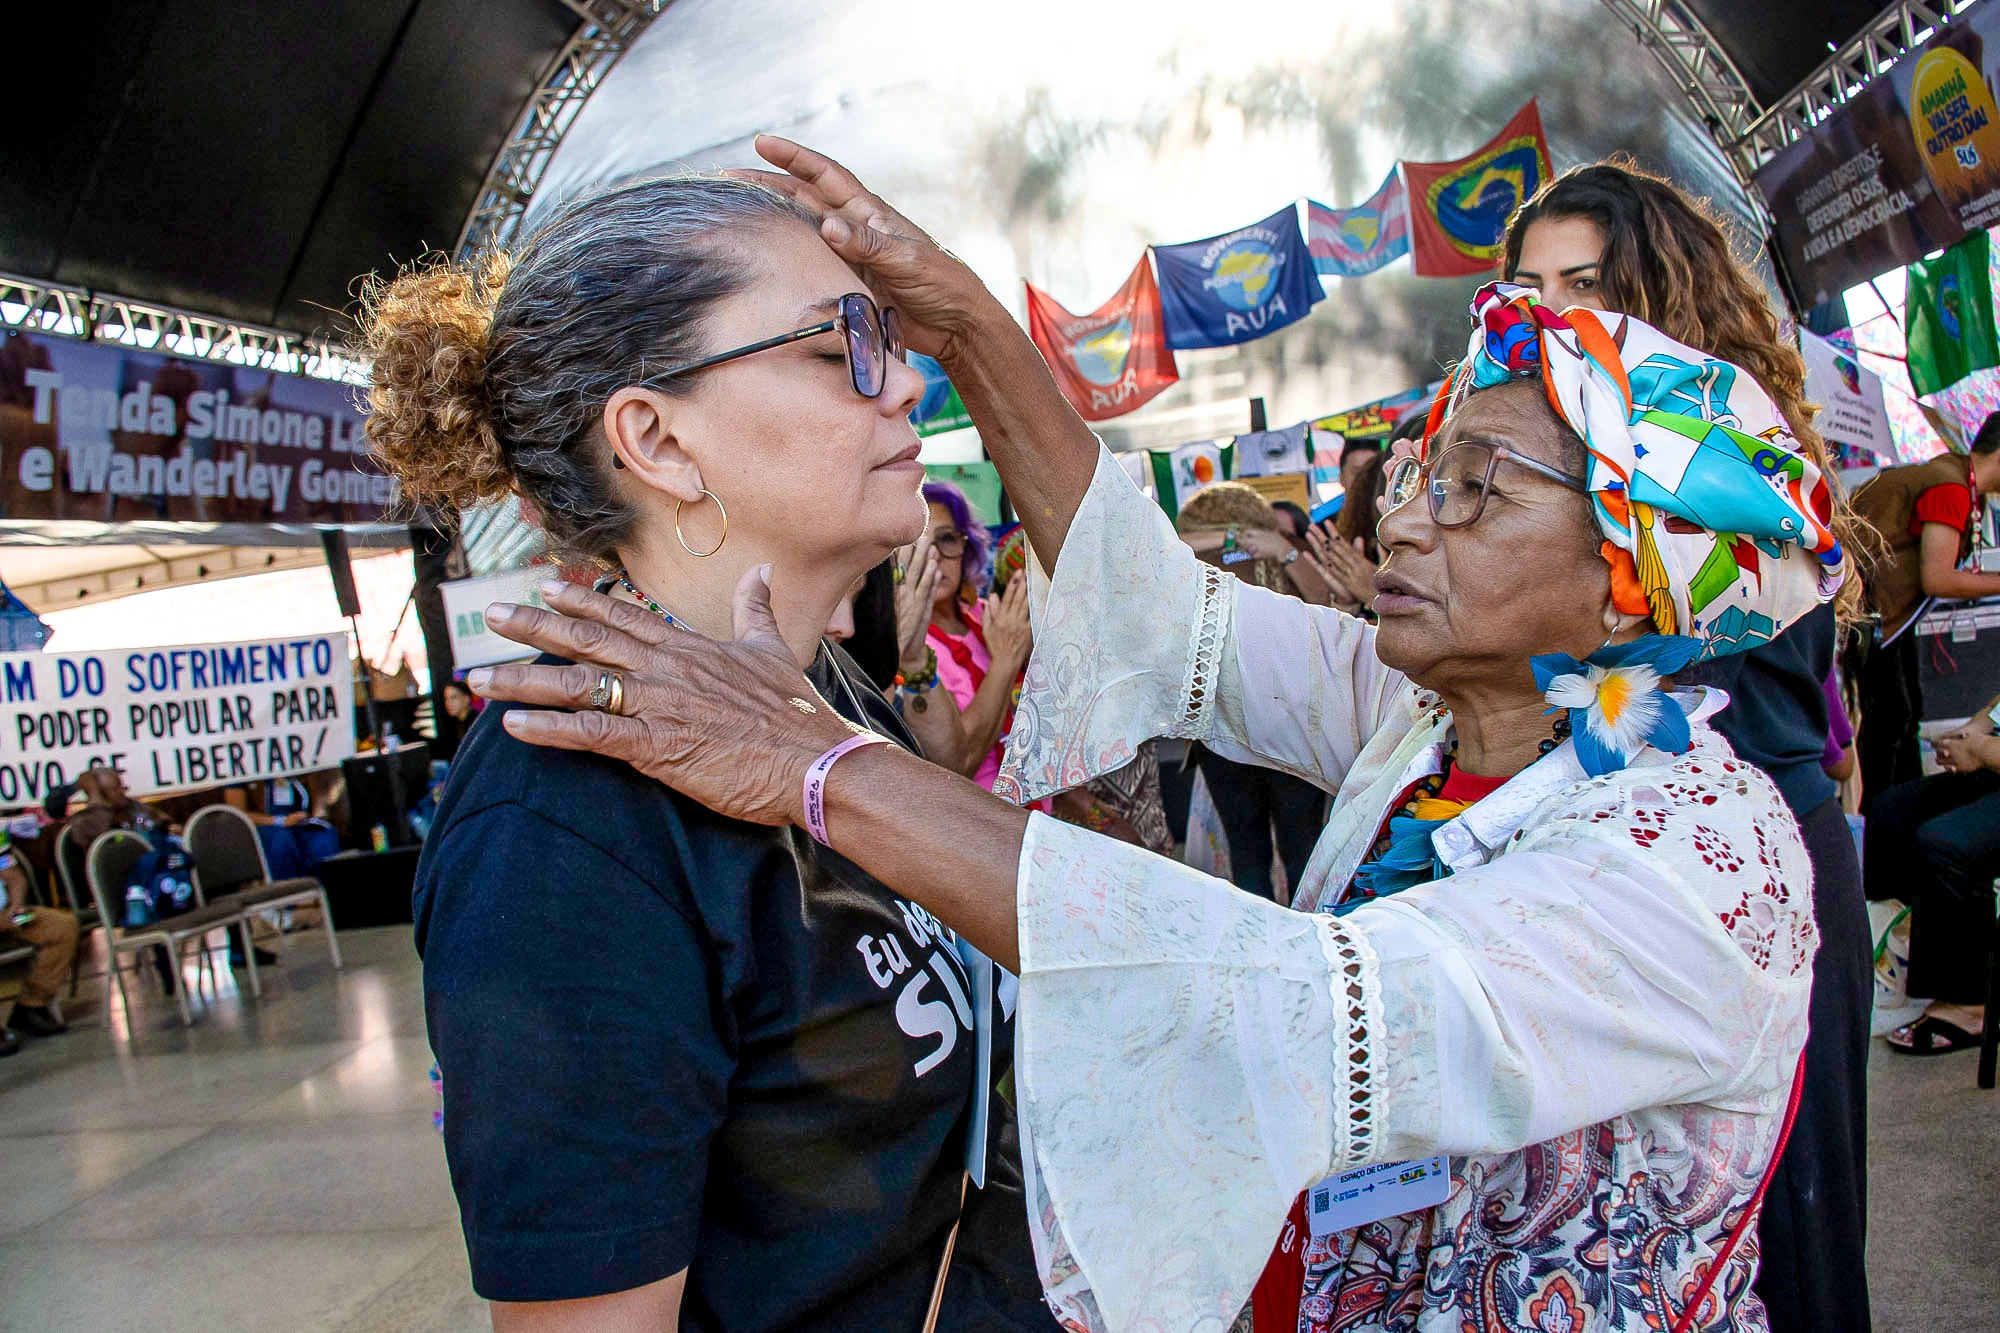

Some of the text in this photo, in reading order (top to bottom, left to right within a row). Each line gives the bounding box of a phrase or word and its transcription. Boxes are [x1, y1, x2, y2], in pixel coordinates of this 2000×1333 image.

[1948, 95, 1971, 118] SER
[1927, 120, 1965, 157] OUTRO
[1956, 144, 1978, 165] SUS
[24, 367, 177, 436] Tenda
[186, 389, 325, 450] Simone
[19, 446, 55, 492] e
[68, 441, 293, 512] Wanderley
[57, 657, 106, 699] DO
[126, 638, 331, 692] SOFRIMENTO
[16, 685, 338, 751] PODER POPULAR PARA
[856, 932, 912, 989] Eu
[1366, 1165, 1377, 1176] DE
